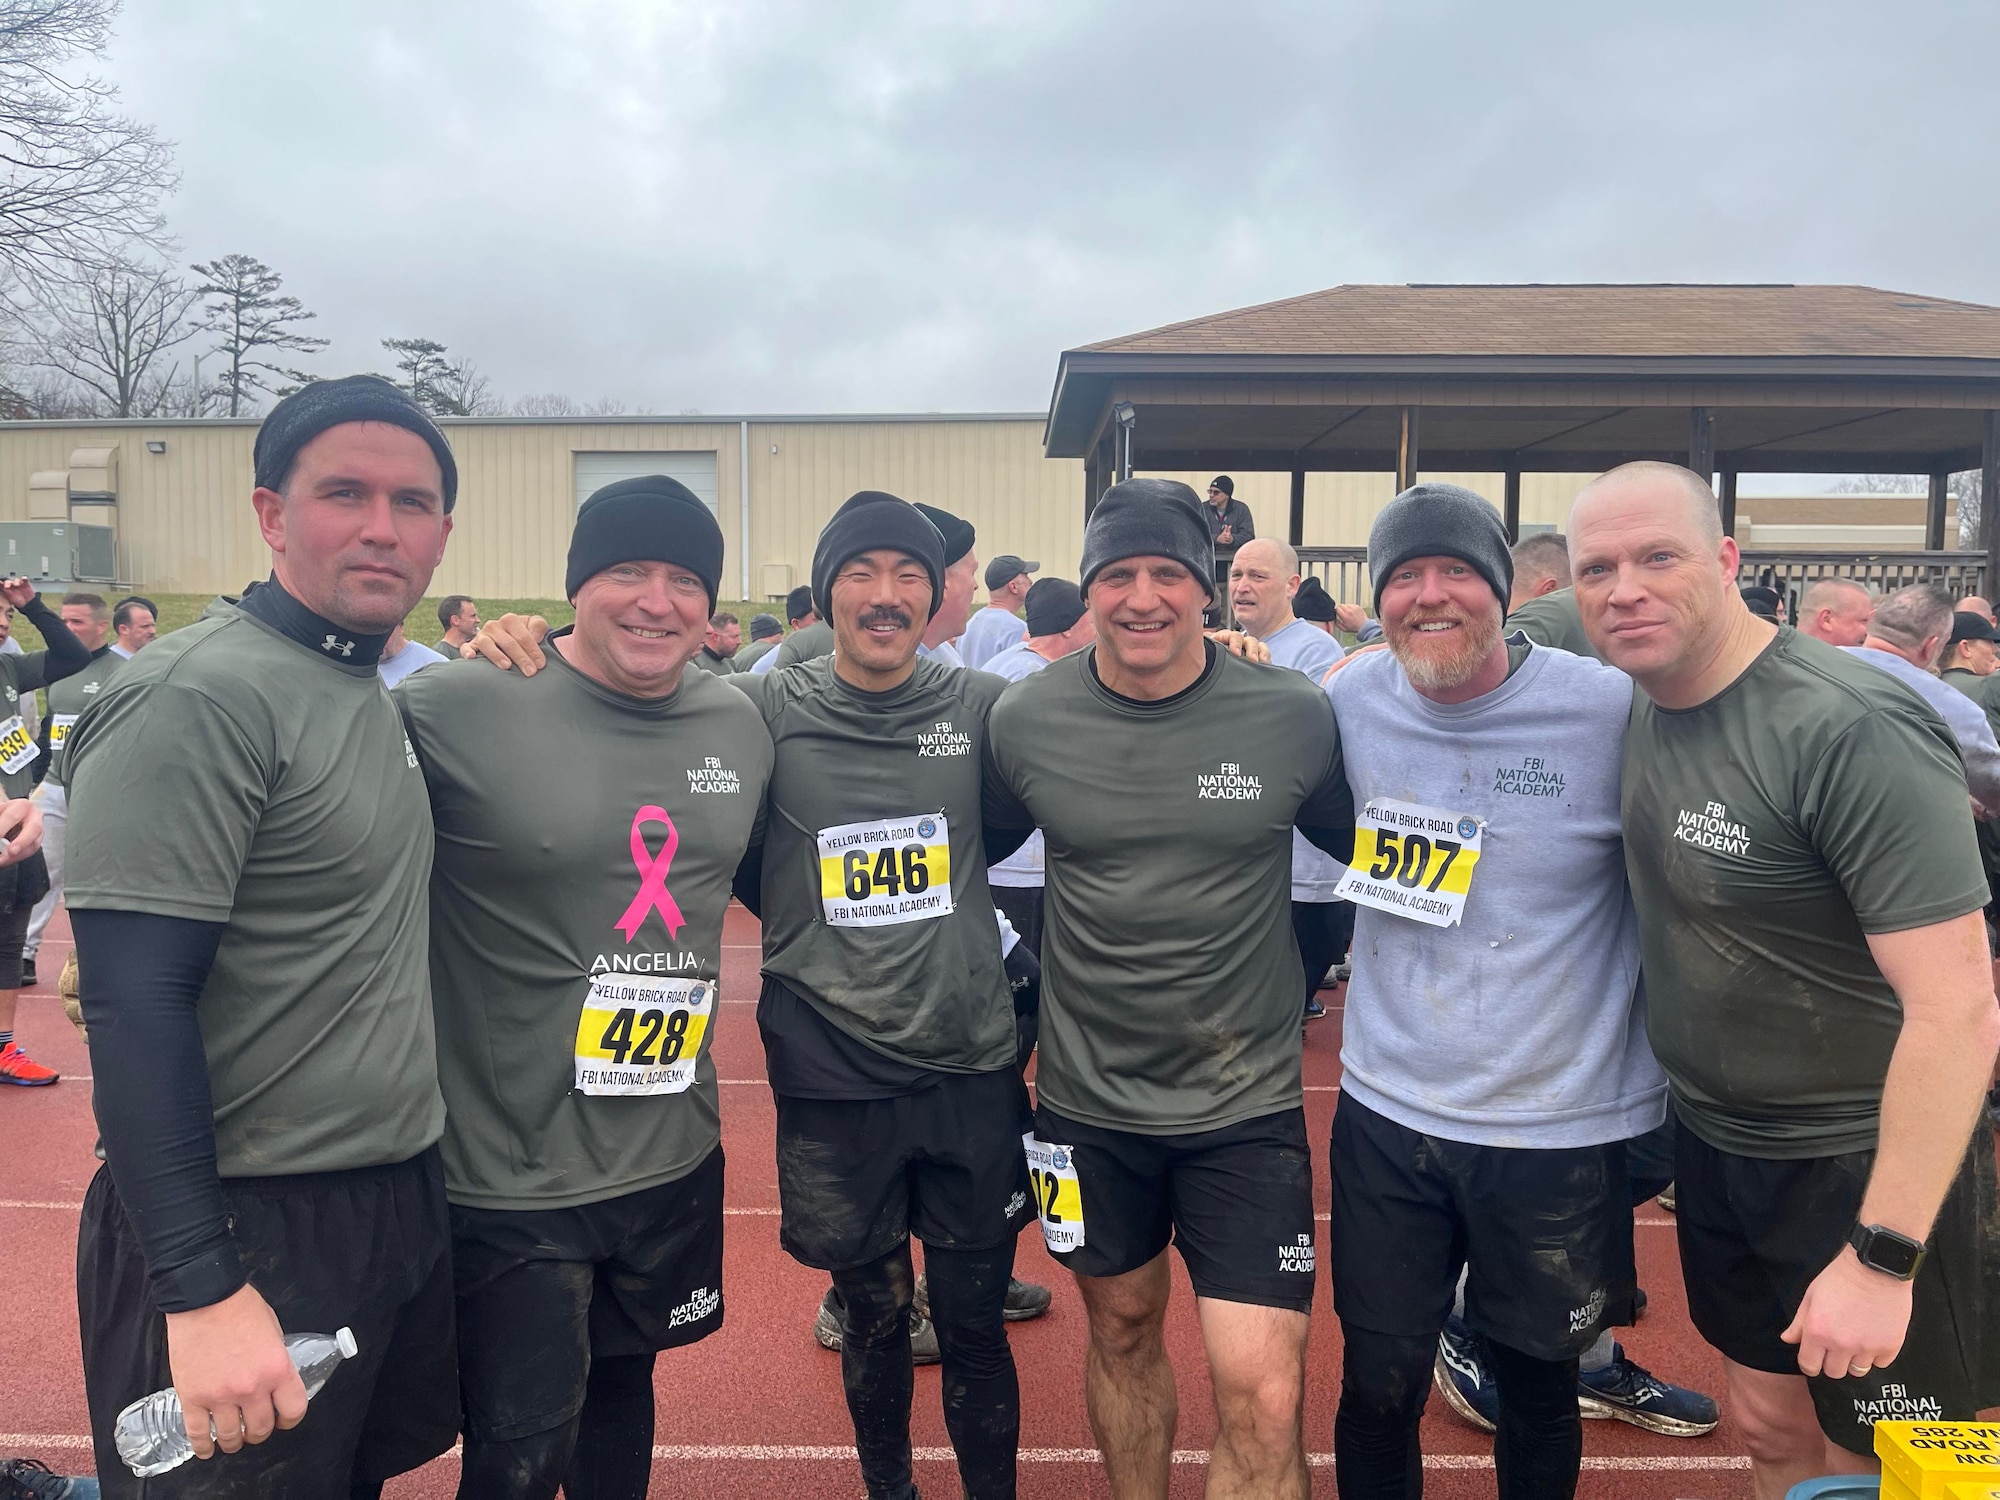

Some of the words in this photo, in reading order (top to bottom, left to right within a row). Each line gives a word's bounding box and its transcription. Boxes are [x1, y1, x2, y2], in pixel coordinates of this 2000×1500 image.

[935, 722, 952, 732] FBI
[0, 730, 27, 762] 639
[917, 732, 971, 745] NATIONAL
[918, 744, 971, 757] ACADEMY
[704, 757, 721, 769] FBI
[1221, 763, 1240, 775] FBI
[1524, 757, 1545, 770] FBI
[686, 769, 740, 782] NATIONAL
[1197, 774, 1262, 788] NATIONAL
[1496, 768, 1566, 785] NATIONAL
[690, 781, 740, 794] ACADEMY
[1198, 787, 1262, 800] ACADEMY
[1493, 781, 1565, 797] ACADEMY
[1705, 801, 1726, 819] FBI
[1366, 807, 1398, 824] YELLOW
[1399, 813, 1426, 830] BRICK
[1428, 819, 1453, 834] ROAD
[1677, 809, 1751, 841] NATIONAL
[826, 836, 862, 849] YELLOW
[864, 830, 890, 843] BRICK
[891, 827, 914, 840] ROAD
[1673, 824, 1751, 855] ACADEMY
[1369, 827, 1462, 893] 507
[843, 843, 929, 901] 646
[1348, 880, 1364, 894] FBI
[1364, 884, 1407, 907] NATIONAL
[1408, 896, 1452, 917] ACADEMY
[834, 908, 849, 919] FBI
[851, 903, 897, 919] NATIONAL
[899, 895, 941, 914] ACADEMY
[590, 951, 698, 973] ANGELIA
[598, 984, 637, 1001] YELLOW
[639, 988, 667, 1003] BRICK
[666, 991, 688, 1003] ROAD
[600, 1007, 690, 1066] 428
[581, 1070, 599, 1084] FBI
[601, 1070, 645, 1086] NATIONAL
[646, 1070, 685, 1084] ACADEMY
[1297, 1233, 1310, 1246] FBI
[1278, 1245, 1315, 1259] NATION
[691, 1286, 707, 1302] FBI
[670, 1289, 720, 1318] NATIONAL
[668, 1297, 720, 1329] ACADEMY
[1881, 1383, 1907, 1398] FBI
[1853, 1396, 1942, 1414] NATIONAL
[1912, 1427, 1964, 1437] 285
[1910, 1439, 1992, 1451] ROAD
